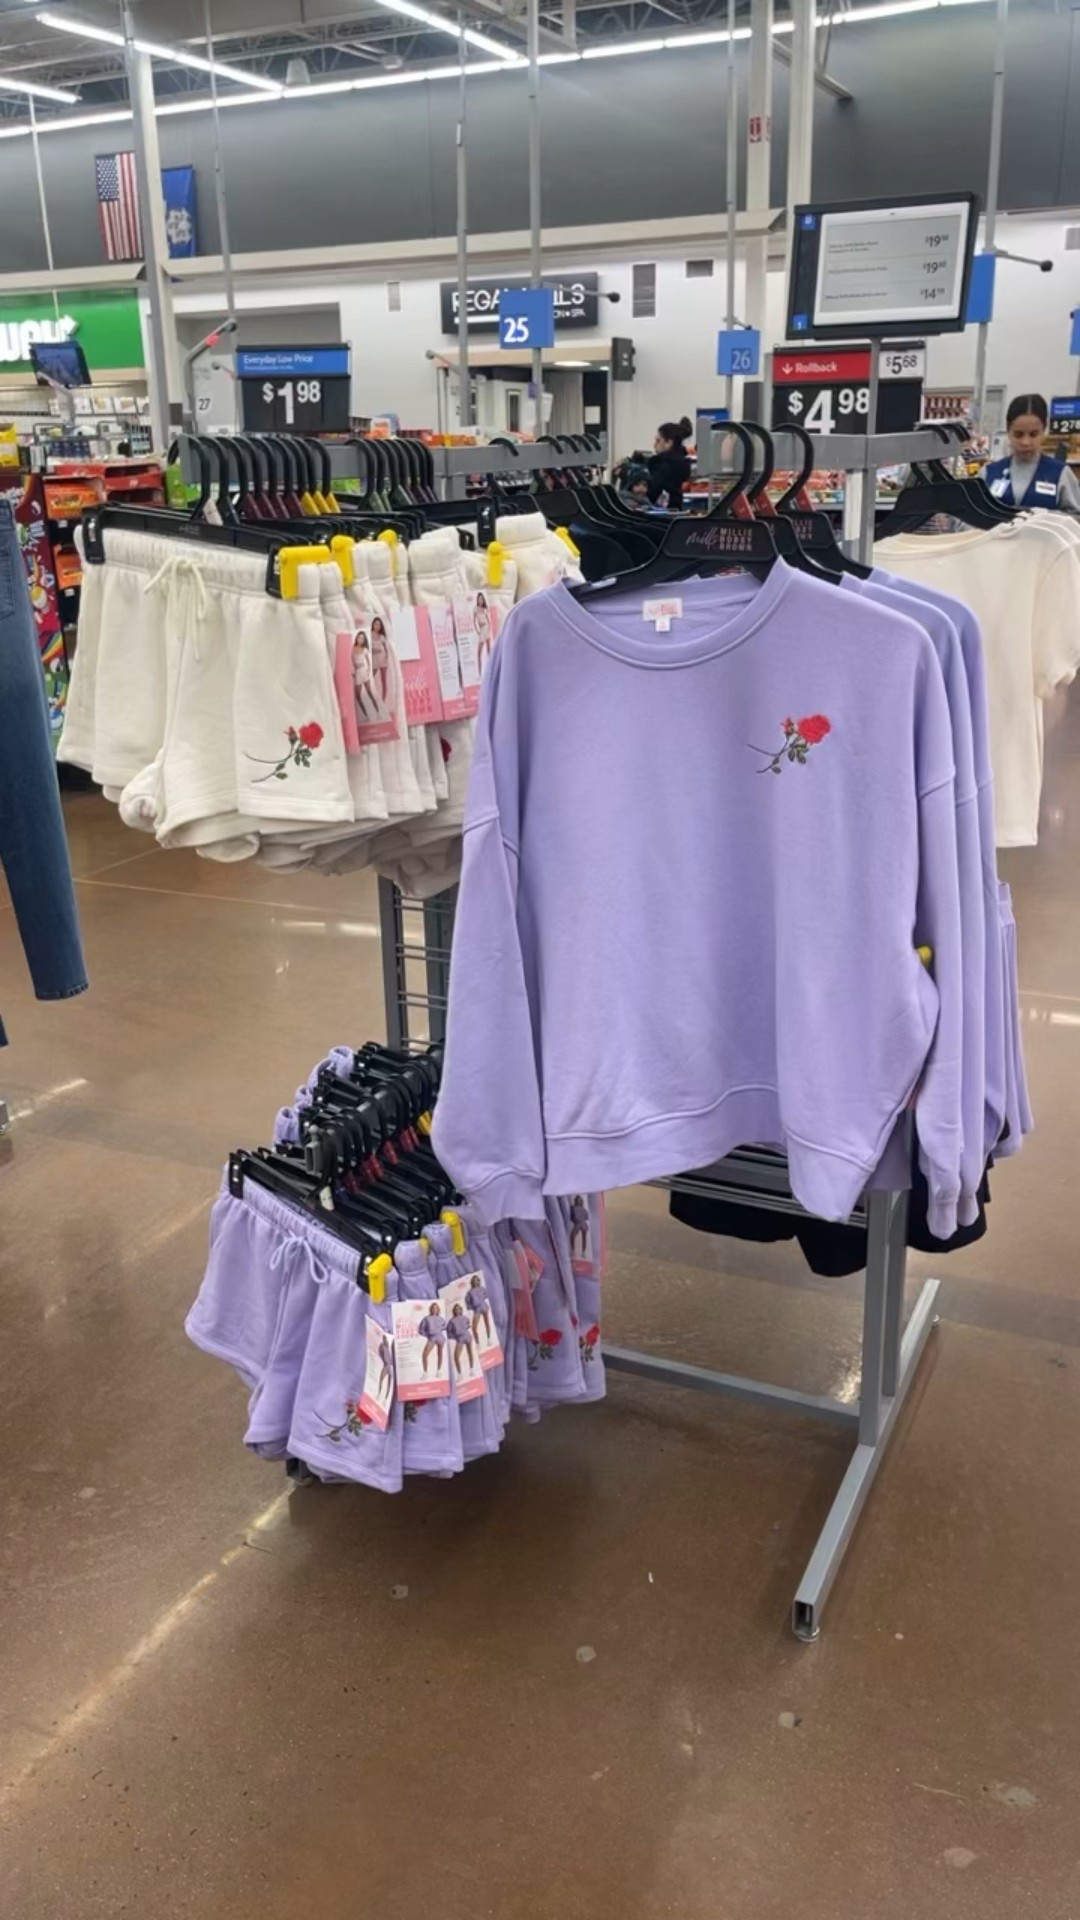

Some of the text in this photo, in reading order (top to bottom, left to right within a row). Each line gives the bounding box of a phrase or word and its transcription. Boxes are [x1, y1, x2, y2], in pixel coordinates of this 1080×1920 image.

[504, 317, 529, 343] 25
[243, 354, 276, 365] Everyday
[294, 353, 314, 363] Price
[732, 351, 750, 370] 26
[795, 361, 838, 373] Rollback
[199, 398, 211, 410] 27
[262, 381, 321, 424] $198
